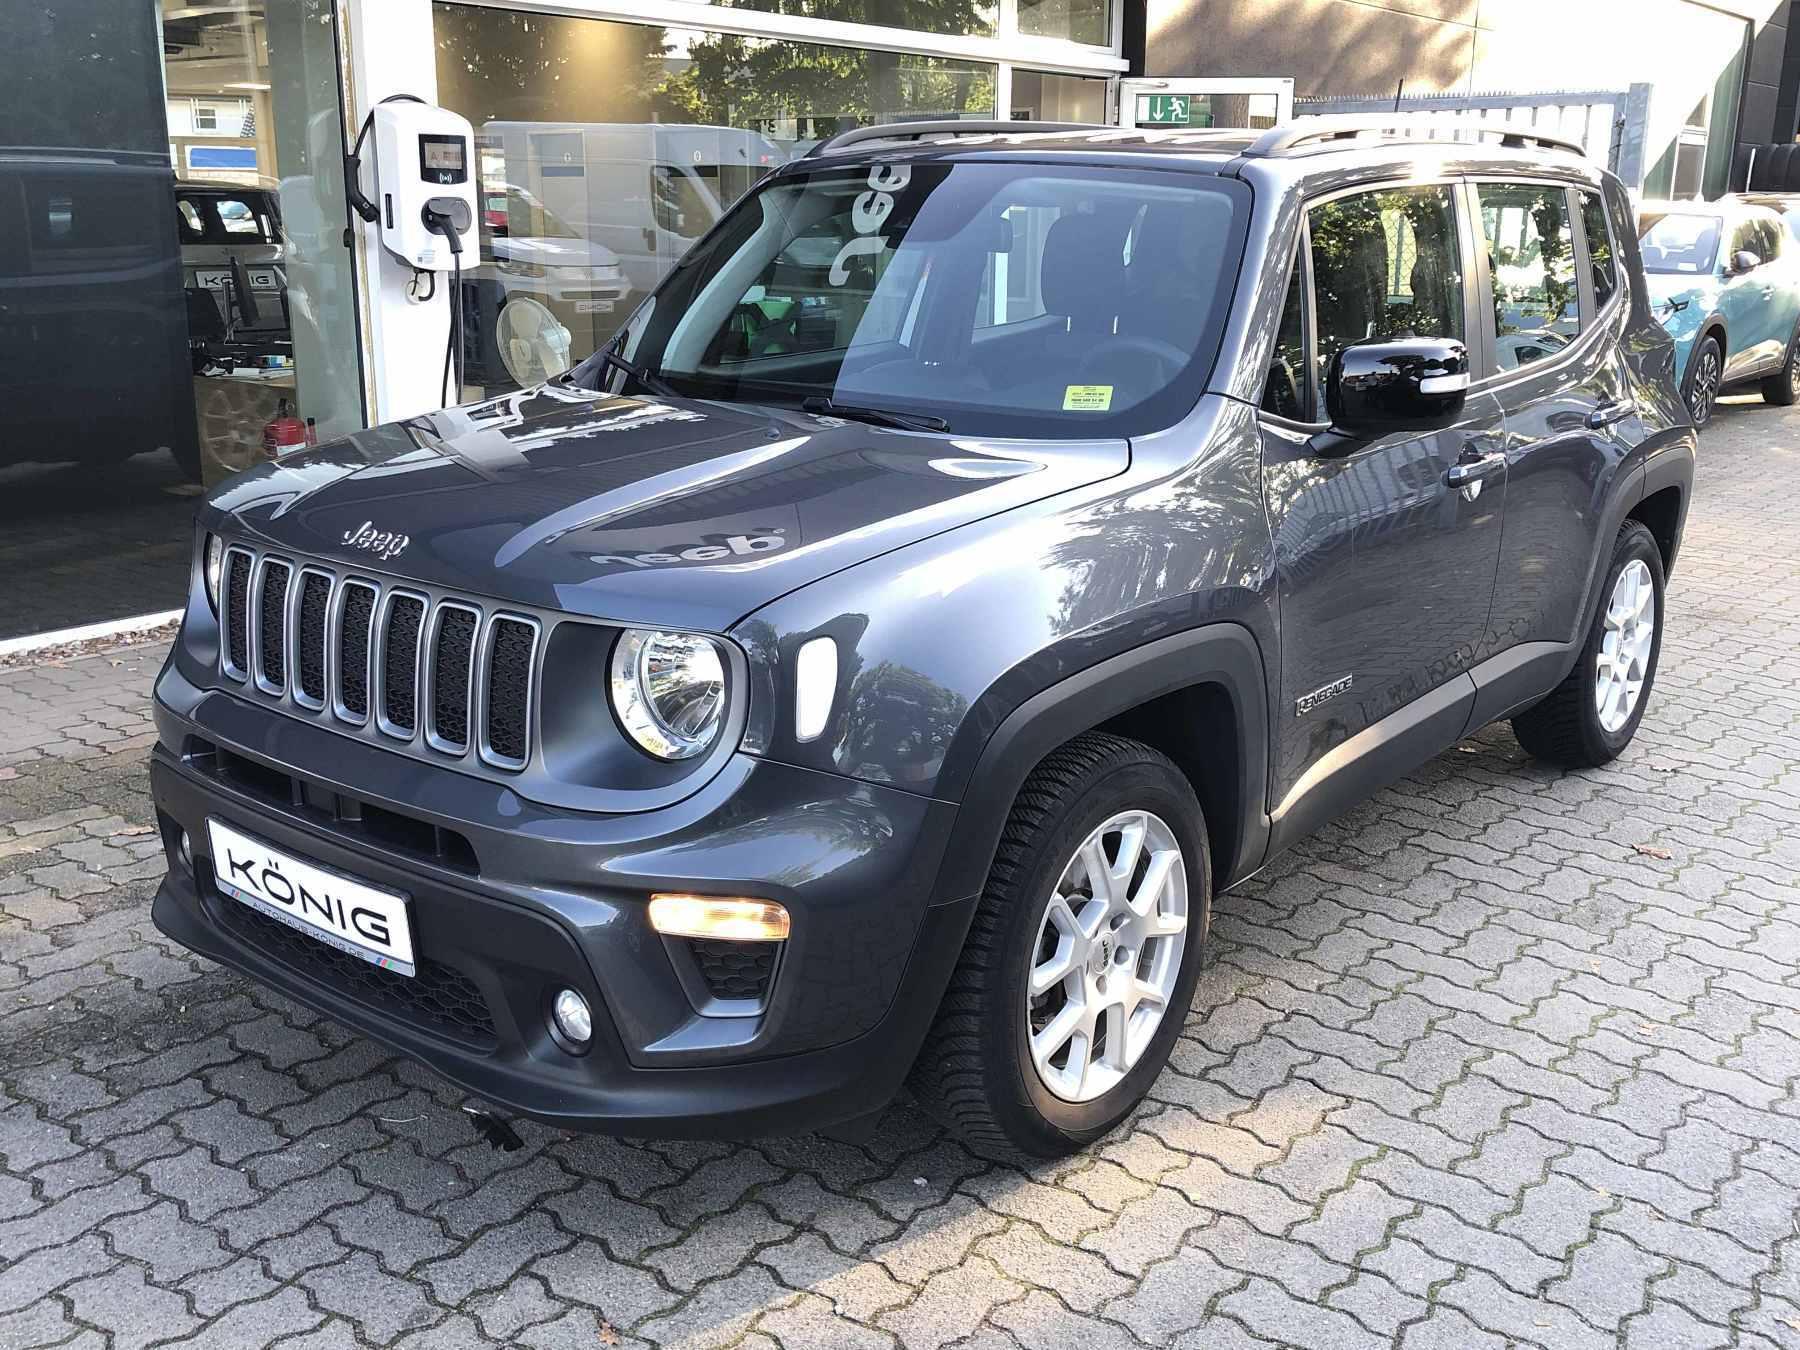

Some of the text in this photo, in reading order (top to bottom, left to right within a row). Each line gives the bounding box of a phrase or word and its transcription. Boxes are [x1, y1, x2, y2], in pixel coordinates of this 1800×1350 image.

[203, 272, 270, 287] KÖIG
[340, 520, 410, 561] Jeep
[1295, 673, 1353, 718] RENEGADE
[226, 847, 392, 947] KÖNIG
